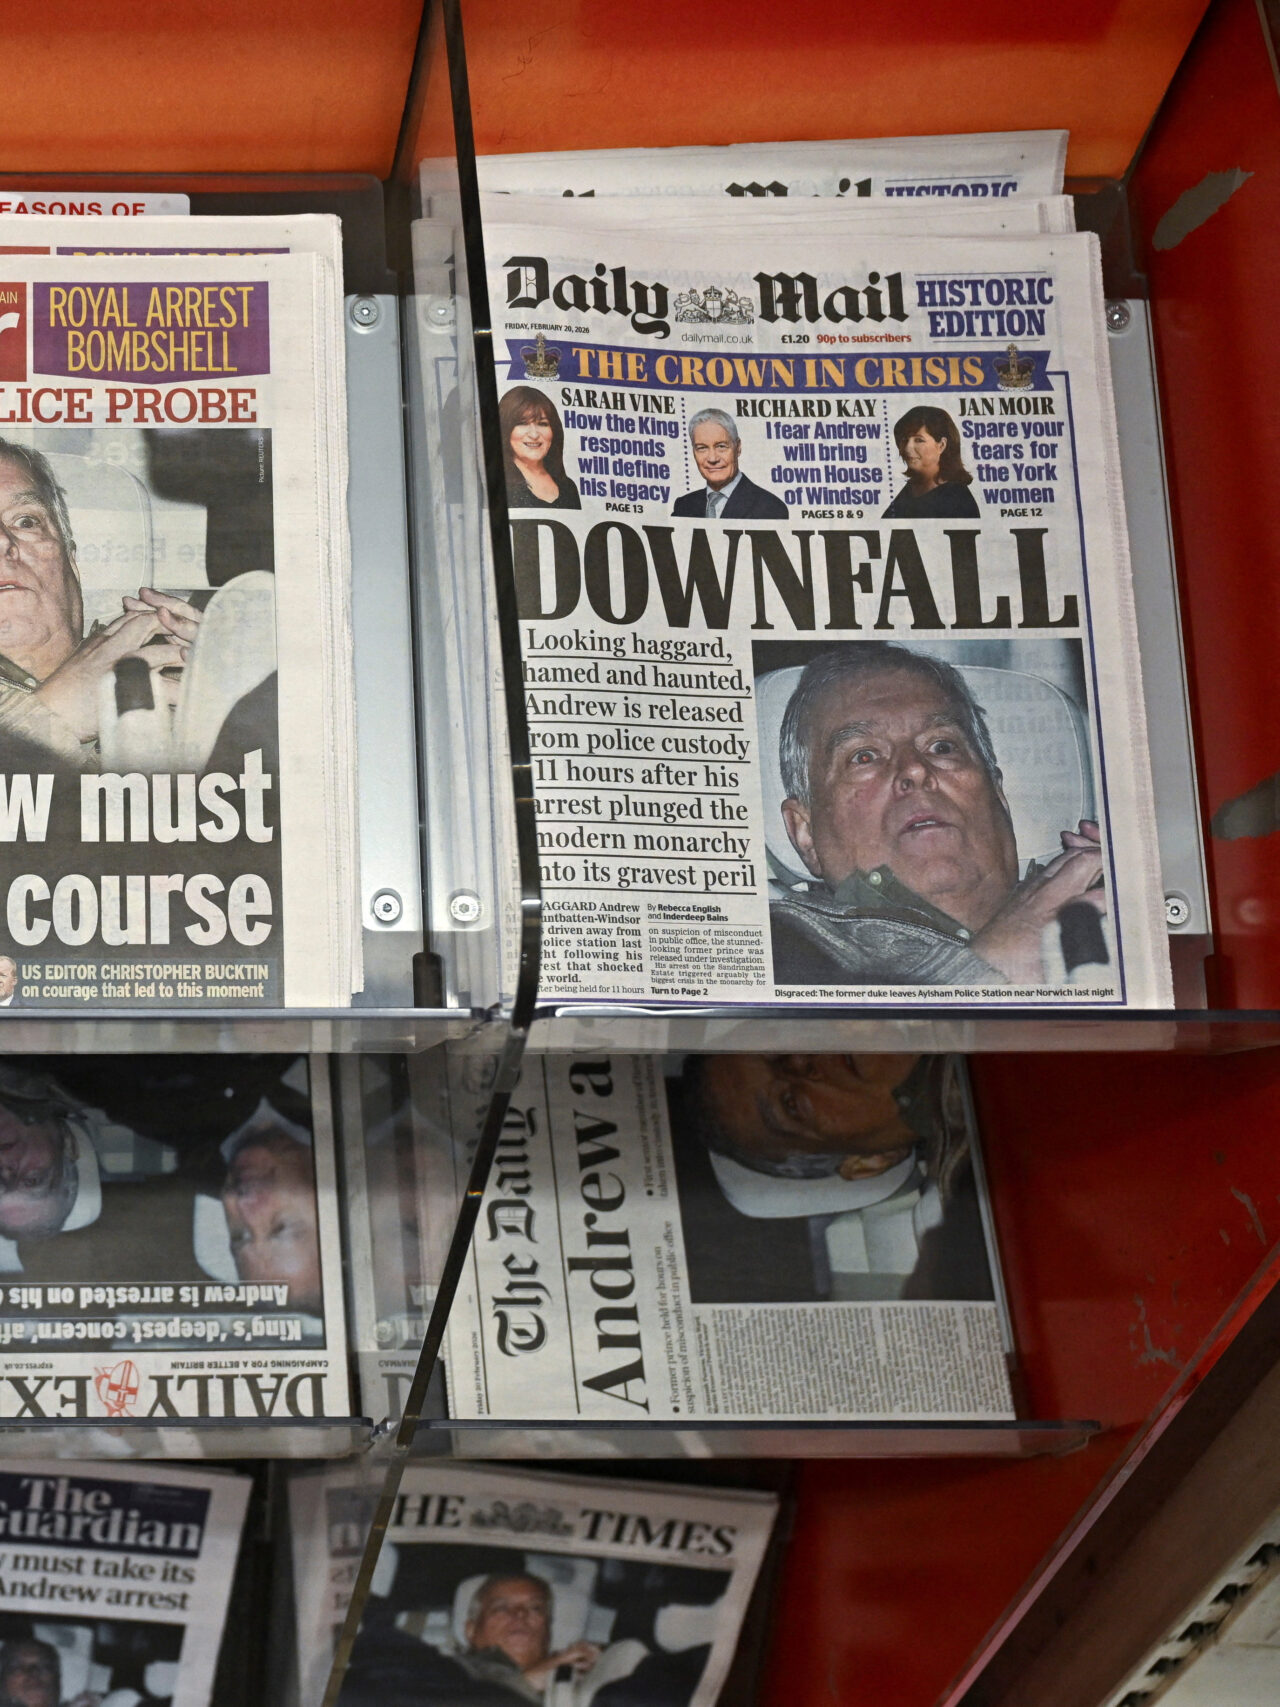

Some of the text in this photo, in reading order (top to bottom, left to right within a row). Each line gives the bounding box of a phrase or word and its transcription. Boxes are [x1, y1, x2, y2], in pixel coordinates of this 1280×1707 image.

[49, 286, 253, 328] ROYAL ARREST
[503, 256, 910, 339] Daily Mail
[917, 278, 1053, 308] HISTORIC
[681, 333, 912, 347] dailymail.co.uk £1.20 90p to subscribers
[928, 310, 1046, 338] EDITION
[67, 331, 237, 372] BOMBSHELL
[572, 347, 985, 388] THE CROWN IN CRISIS
[106, 388, 257, 423] PROBE
[561, 388, 676, 414] SARAH VINE
[736, 399, 877, 418] RICHARD KAY
[958, 397, 1055, 417] JAN MOIR
[512, 518, 1079, 631] DOWNFALL
[527, 628, 732, 662] Looking haggard,
[80, 747, 274, 843] must
[7, 872, 272, 947] course
[647, 904, 721, 914] By Rebecca English
[487, 1106, 552, 1358] The Daily
[567, 1109, 650, 1415] Andrew
[654, 1264, 668, 1292] hours
[9, 1287, 43, 1309] his
[48, 1288, 75, 1304] on
[80, 1287, 174, 1309] arrested
[180, 1286, 199, 1308] is
[204, 1285, 288, 1307] Andrew
[233, 1316, 302, 1341] King's
[658, 1309, 672, 1331] held
[661, 1332, 677, 1366] prince
[147, 1373, 327, 1417] DAILY
[665, 1368, 682, 1403] Former
[21, 1478, 111, 1514] The
[392, 1494, 738, 1557] HE TIMES
[12, 1551, 84, 1575] must
[93, 1554, 150, 1580] take
[155, 1560, 197, 1585] its
[106, 1587, 190, 1611] arrest
